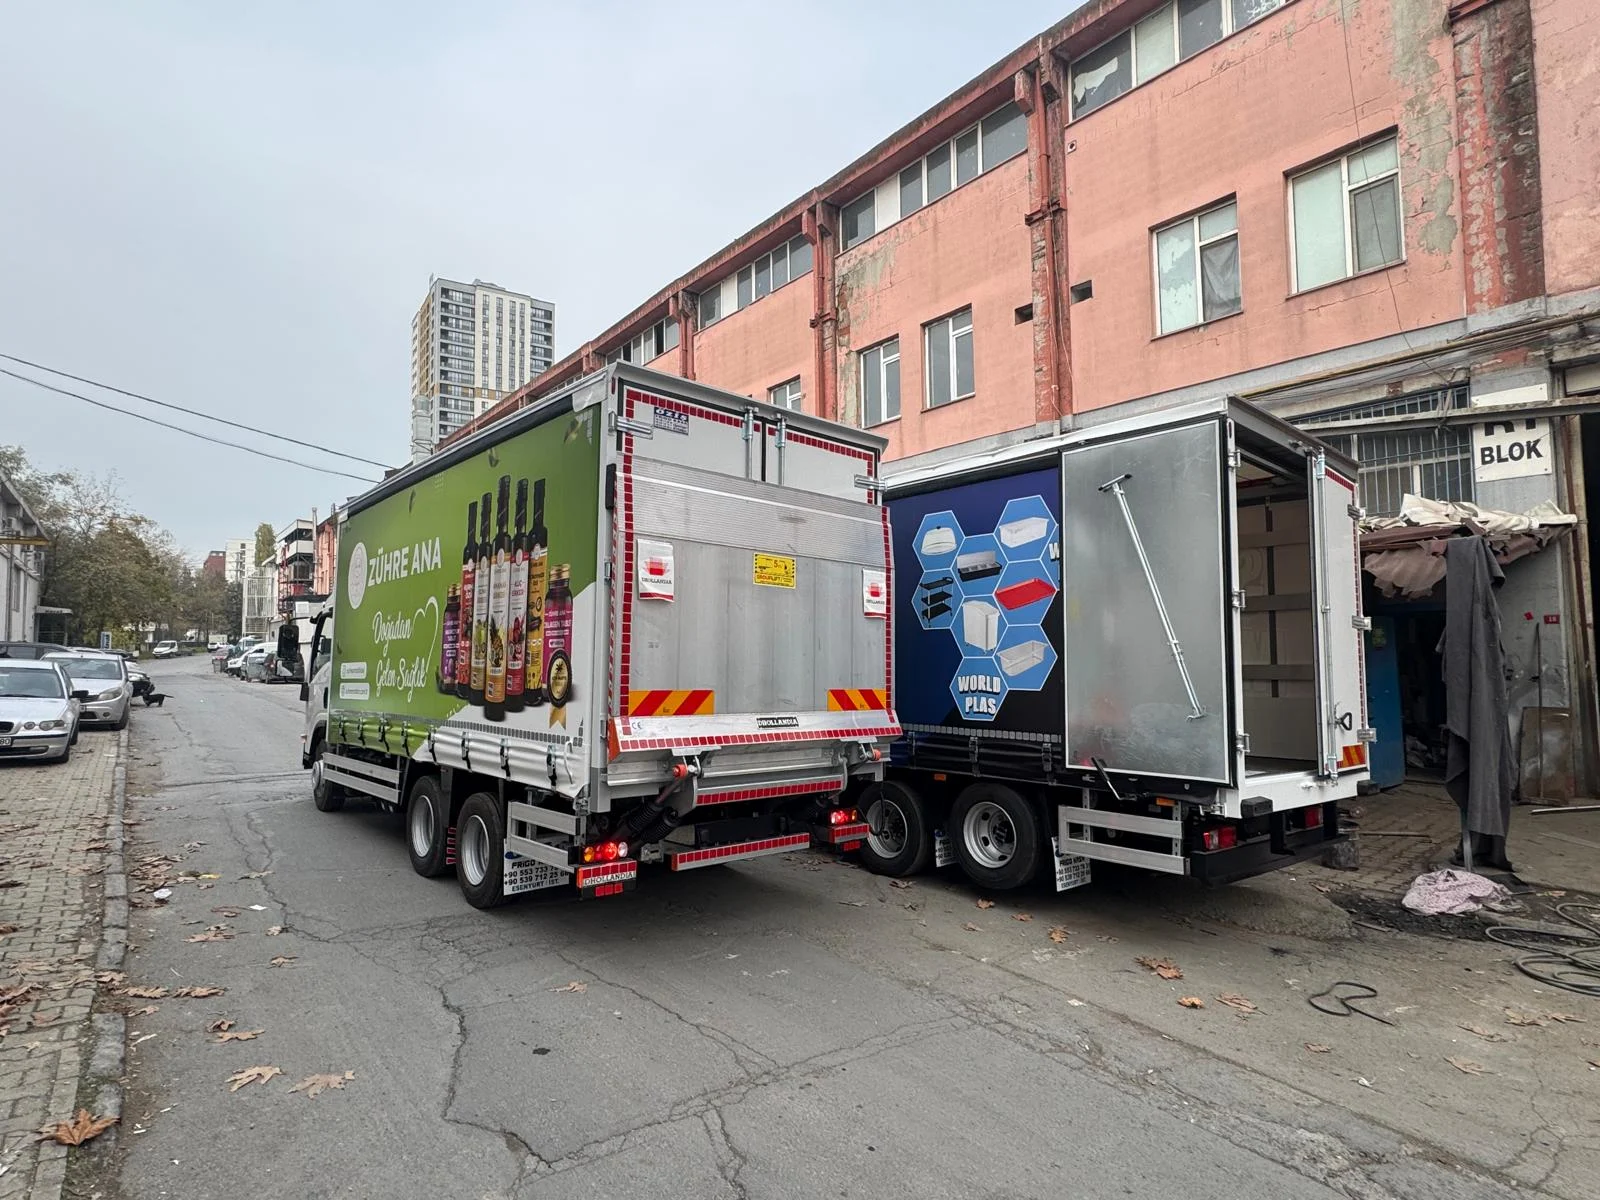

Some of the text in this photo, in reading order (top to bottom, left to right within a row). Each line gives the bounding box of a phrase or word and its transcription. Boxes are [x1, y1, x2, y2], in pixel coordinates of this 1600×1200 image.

[1480, 438, 1543, 466] BLOK
[367, 536, 442, 587] ZÜHRE ANA
[372, 611, 412, 657] Doğadan
[375, 656, 427, 703] Gelen Sağlık
[958, 674, 1001, 694] WORLD
[965, 696, 997, 715] PLAS
[758, 718, 799, 727] DHOLLANDIA
[584, 871, 633, 886] DHOLLANDIA
